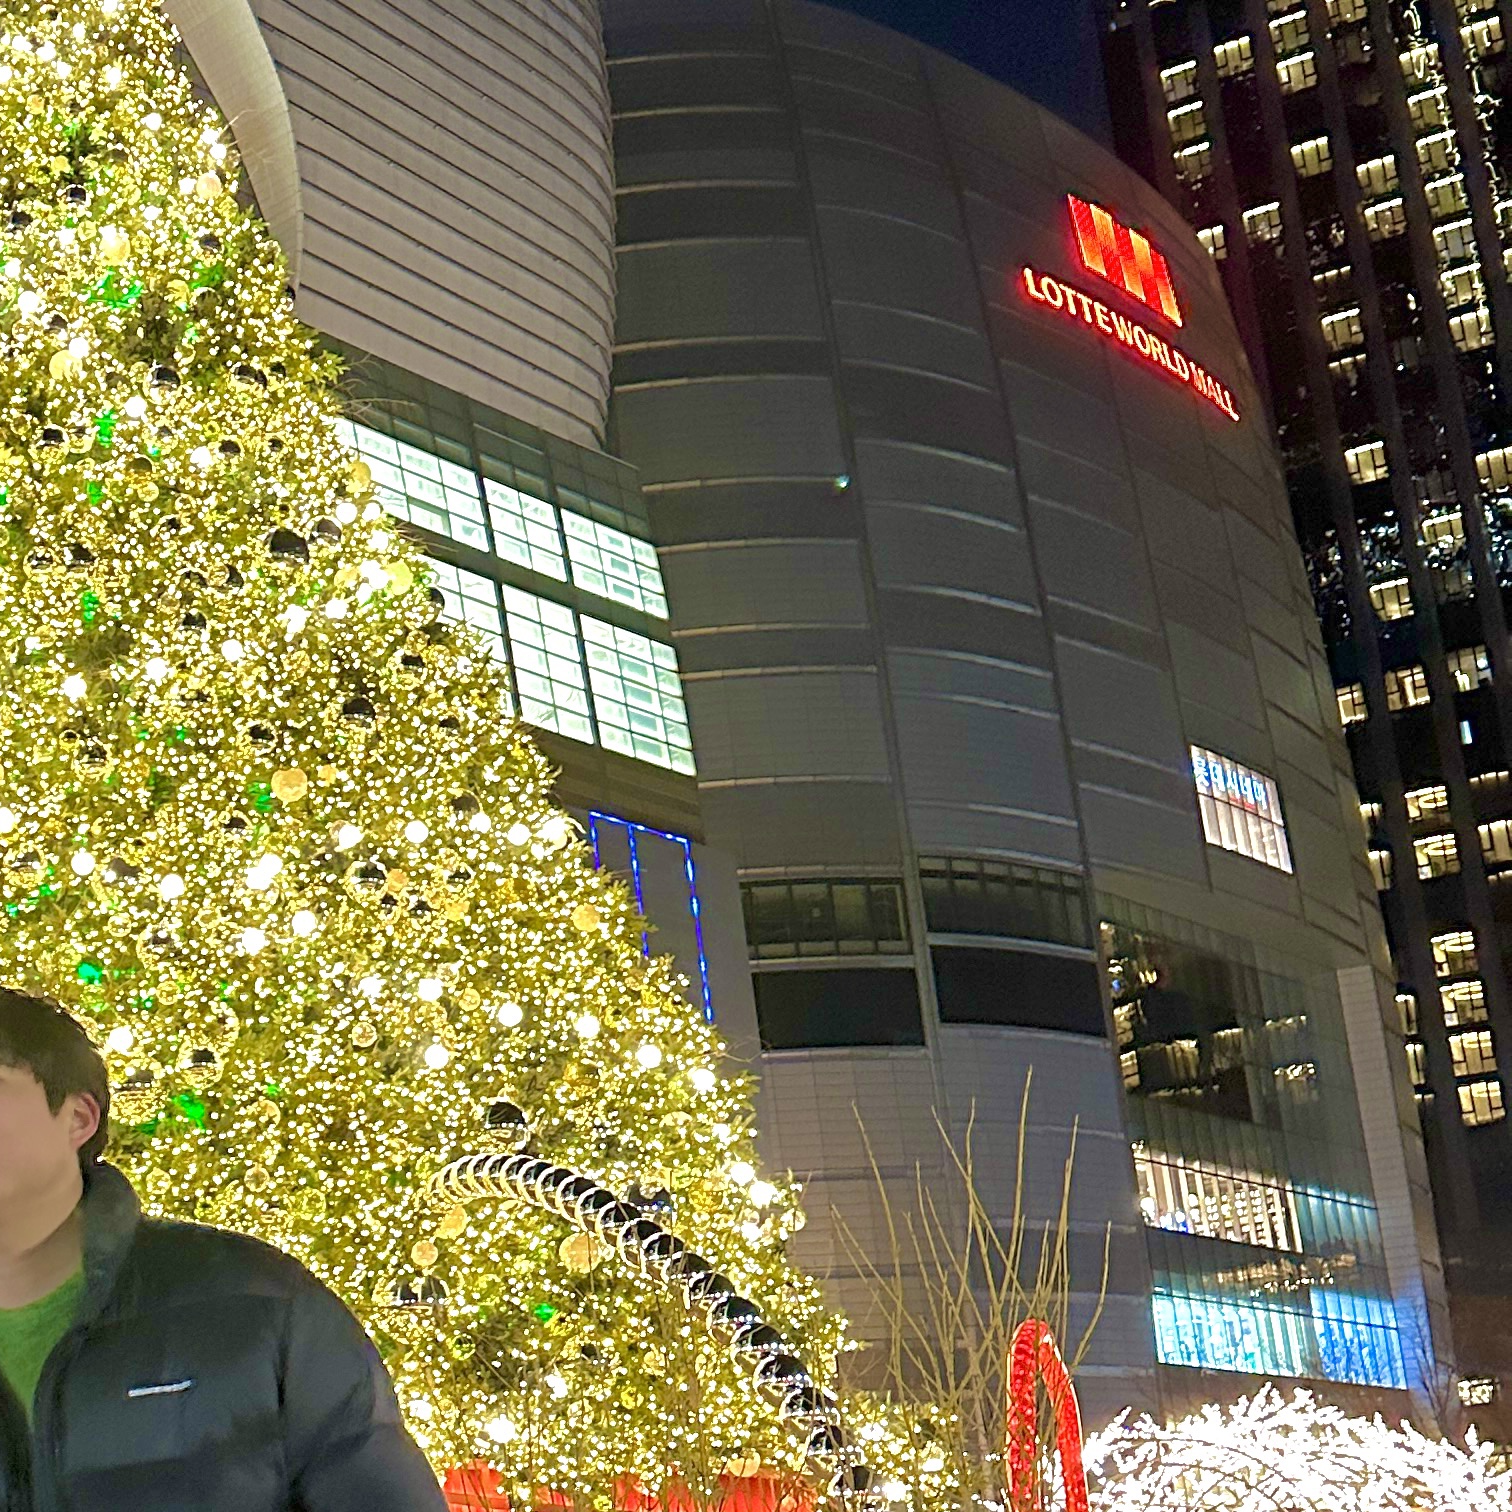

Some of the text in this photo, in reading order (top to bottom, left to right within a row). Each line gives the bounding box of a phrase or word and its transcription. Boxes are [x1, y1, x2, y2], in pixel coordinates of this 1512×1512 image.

[1022, 267, 1240, 422] LOTTE WORLD MALL
